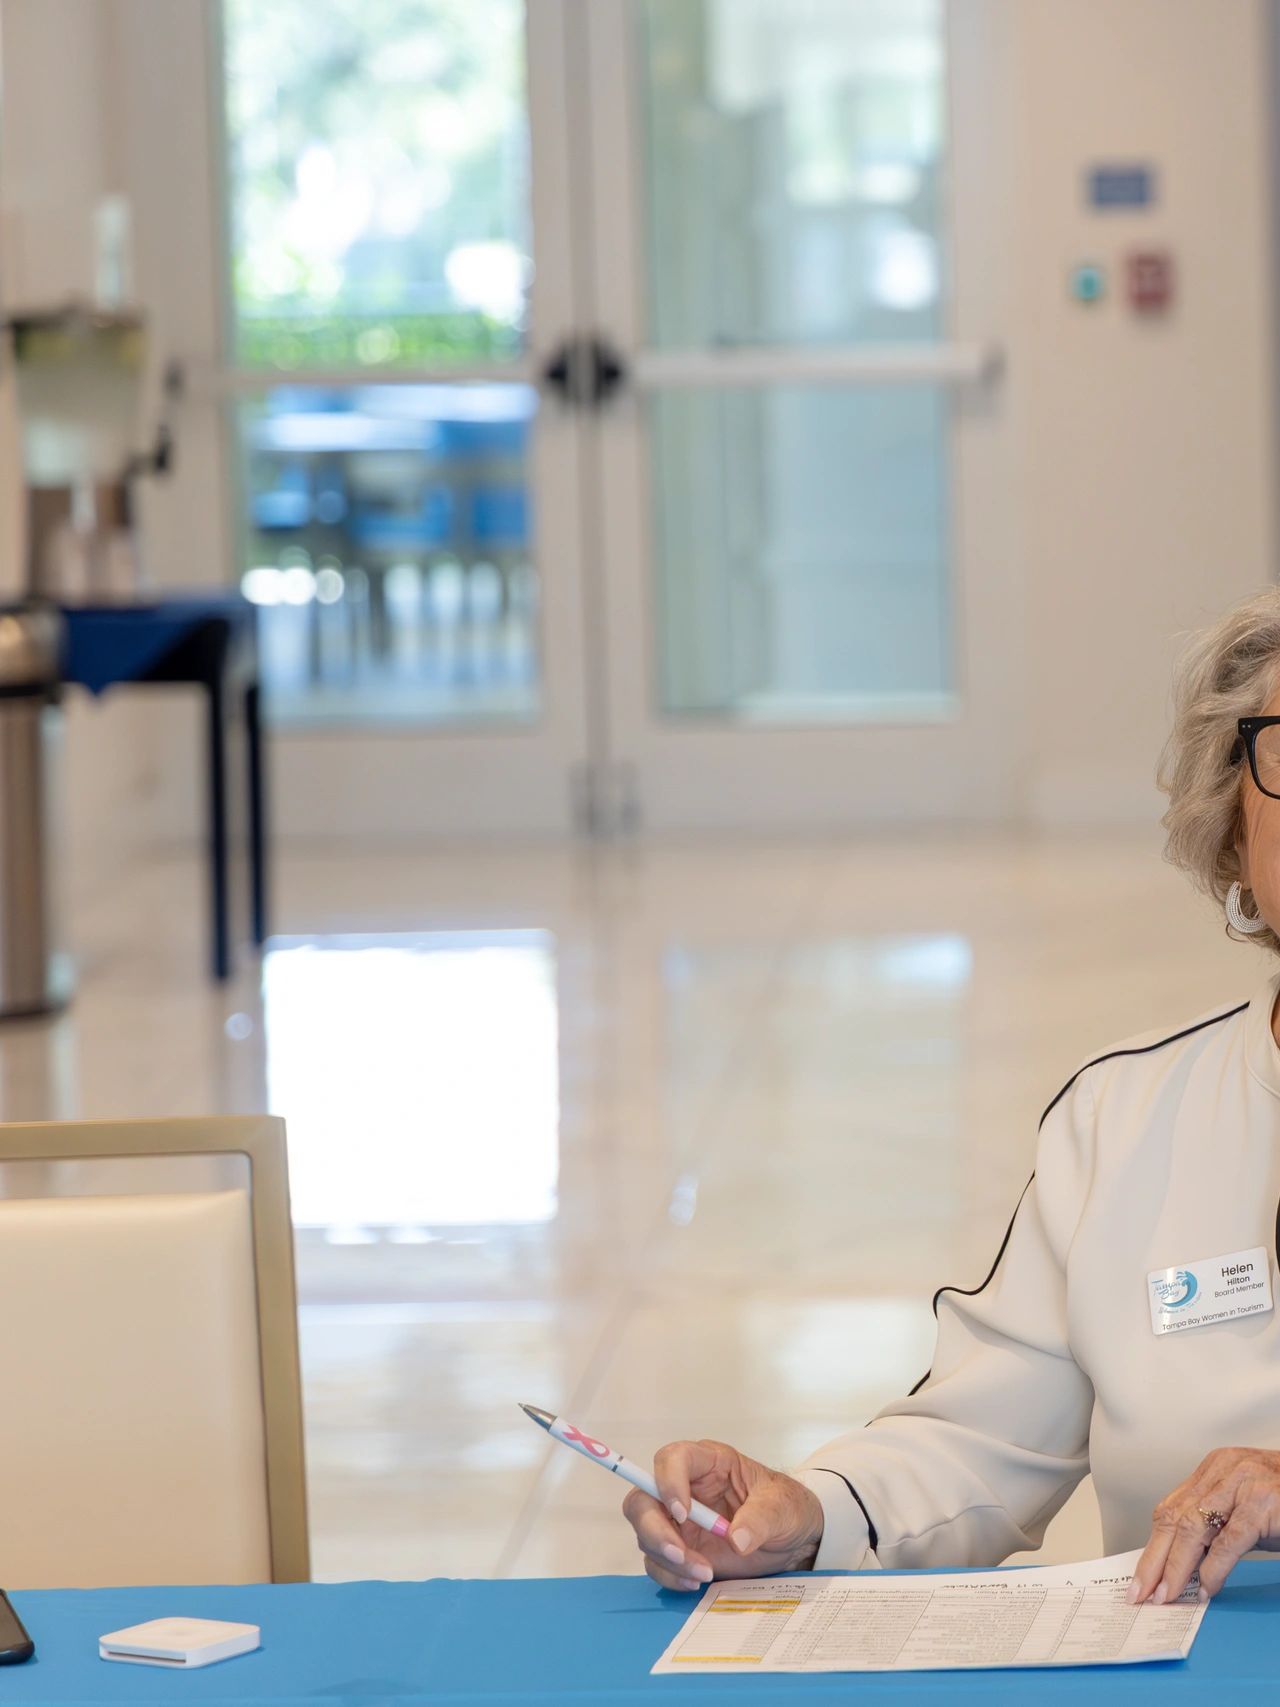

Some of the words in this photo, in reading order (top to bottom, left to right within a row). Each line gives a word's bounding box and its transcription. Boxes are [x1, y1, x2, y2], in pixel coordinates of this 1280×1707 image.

[1221, 1263, 1254, 1277] Helen
[1227, 1276, 1250, 1286] Hilton
[1214, 1288, 1236, 1298] Board
[1236, 1282, 1264, 1293] Member
[1162, 1321, 1187, 1331] Tampa
[1188, 1317, 1201, 1326] Bay
[1201, 1311, 1228, 1322] Women
[1237, 1303, 1264, 1314] Tourism
